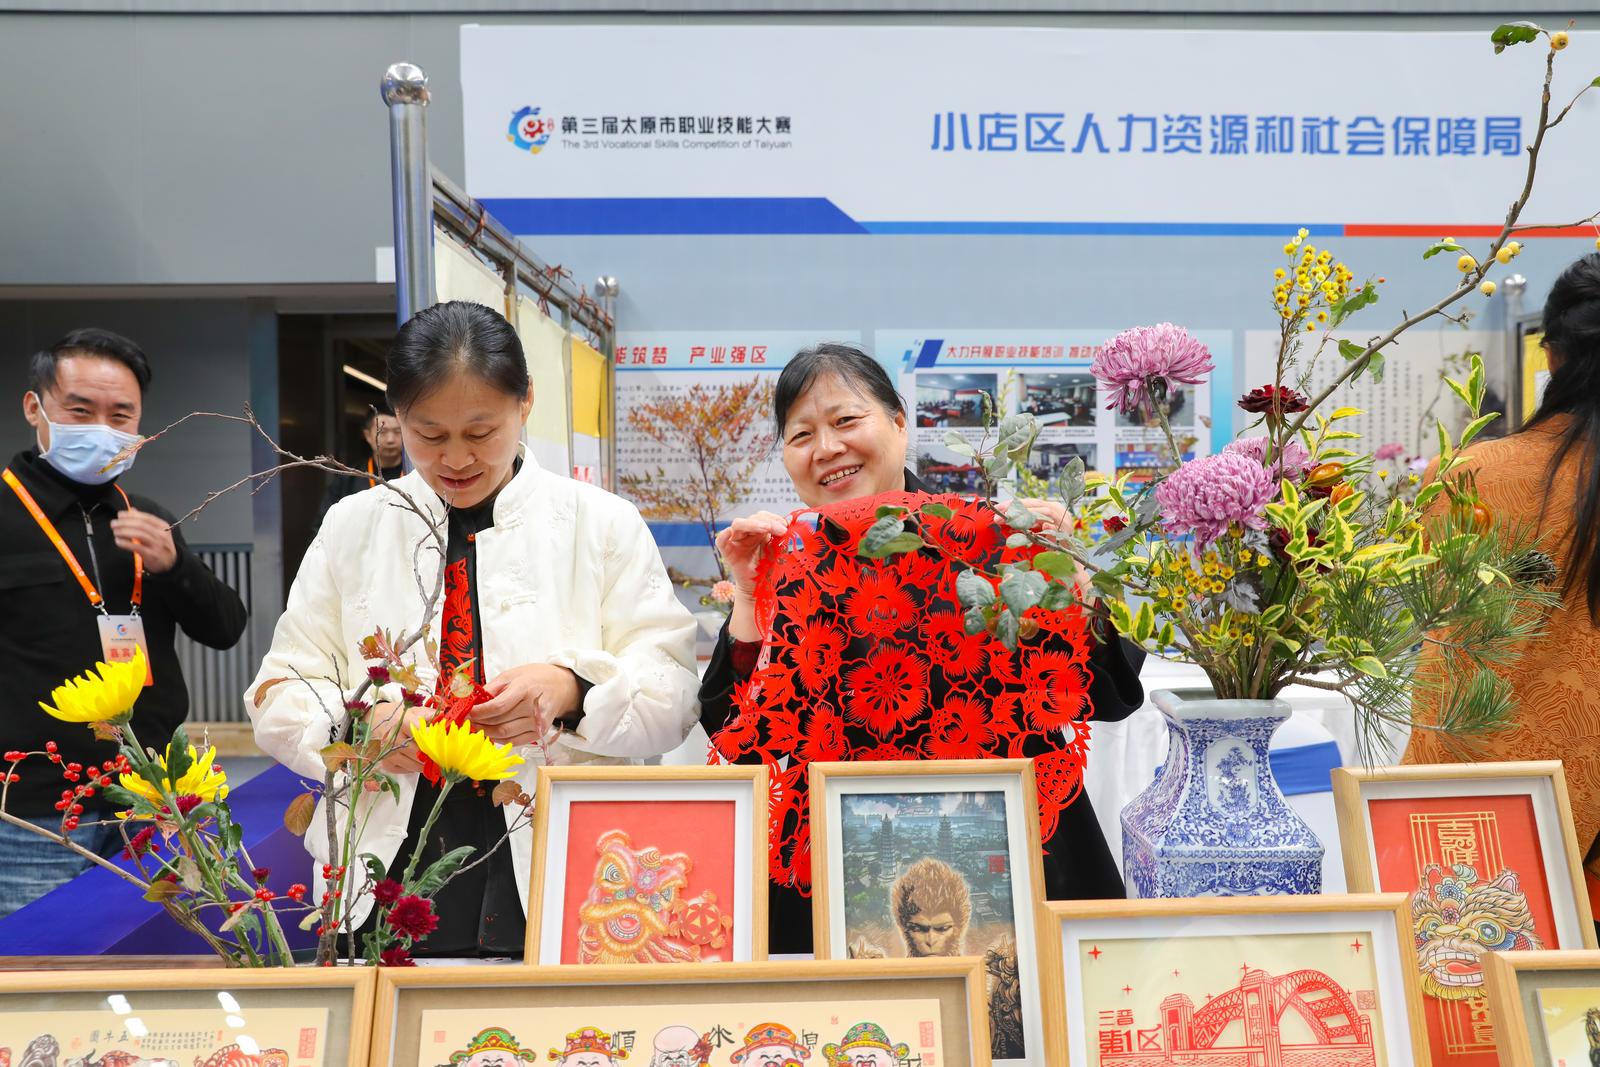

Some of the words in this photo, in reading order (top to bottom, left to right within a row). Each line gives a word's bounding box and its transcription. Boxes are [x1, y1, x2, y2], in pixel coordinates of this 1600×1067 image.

[561, 116, 791, 135] 第三届太原市职业技能大赛
[930, 111, 1522, 157] 小店区人力资源和社会保障局
[561, 139, 581, 149] The
[583, 139, 599, 149] 3rd
[601, 139, 652, 149] Vocational
[655, 139, 680, 149] Skills
[682, 139, 740, 151] Competition
[742, 139, 752, 149] of
[754, 139, 792, 151] Taiyuan
[689, 346, 769, 364] 产业强区
